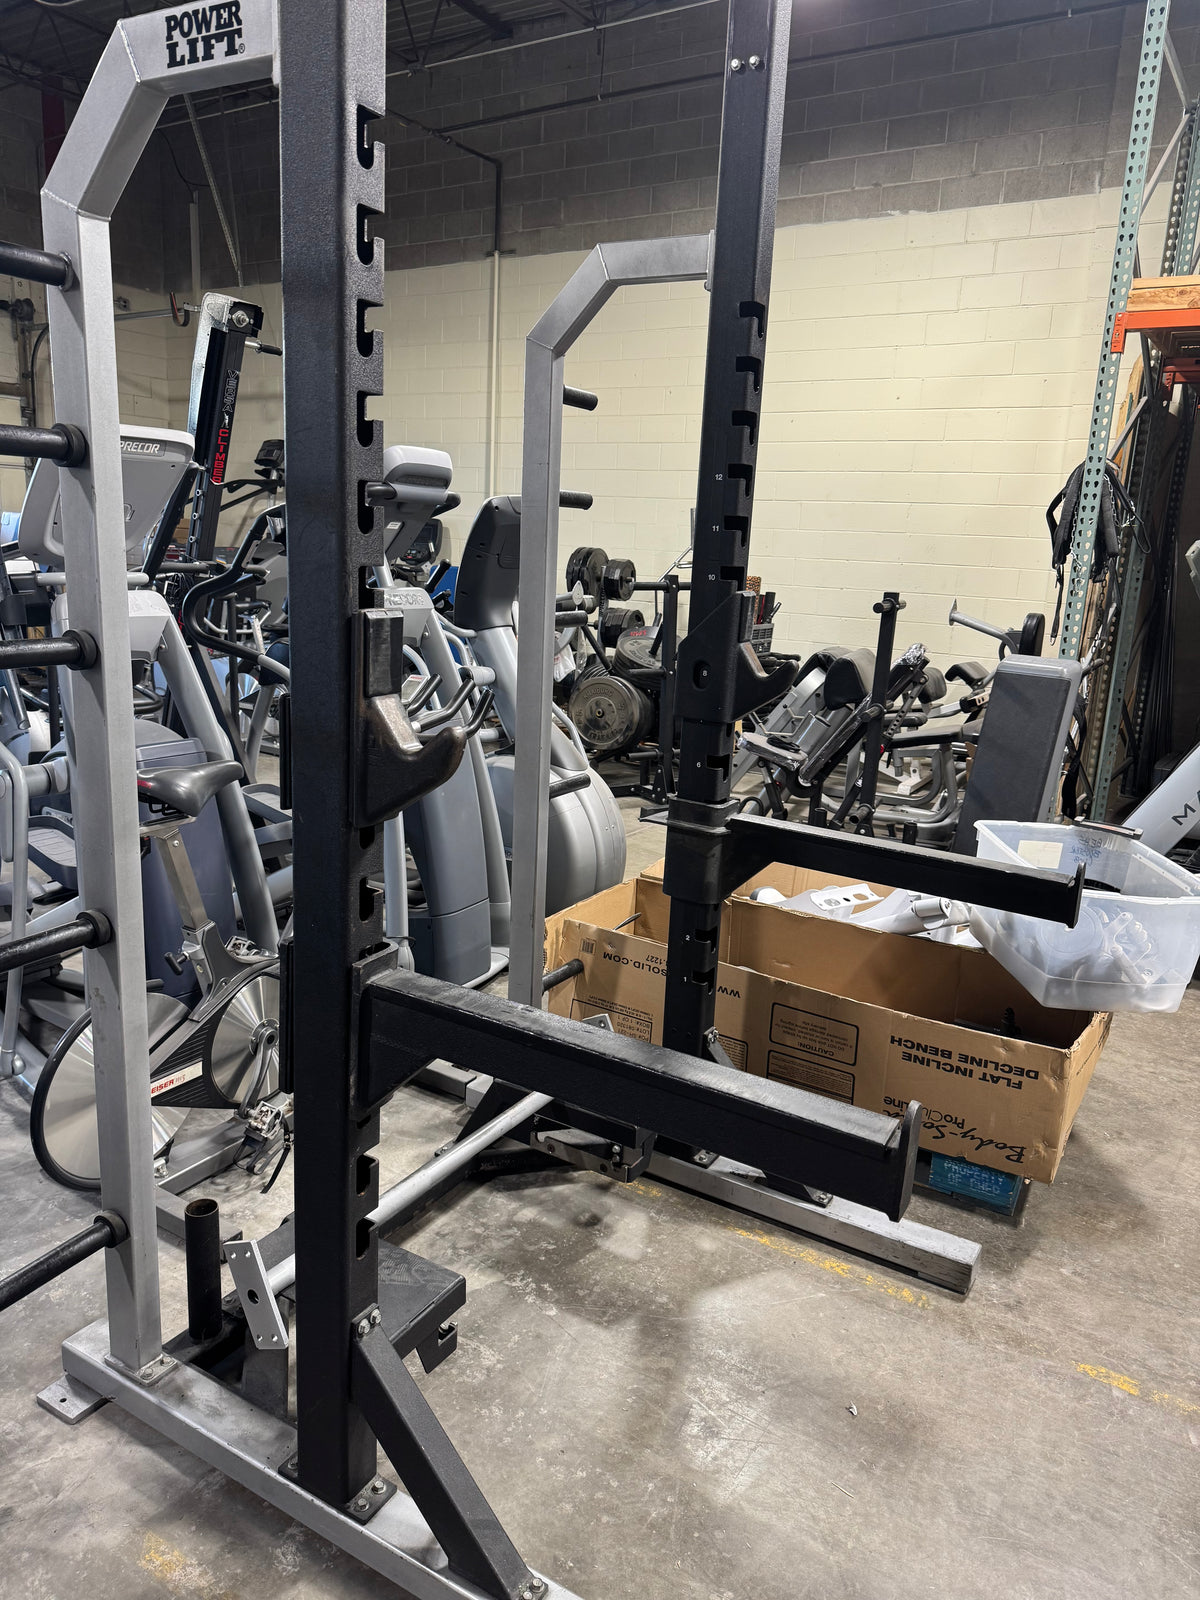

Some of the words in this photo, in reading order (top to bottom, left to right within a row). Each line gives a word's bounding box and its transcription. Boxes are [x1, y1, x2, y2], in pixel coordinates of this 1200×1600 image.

[165, 0, 242, 42] POWER
[166, 27, 242, 69] LIFT
[603, 951, 668, 976] SOLID.COM
[646, 954, 668, 967] .1227
[797, 1041, 834, 1057] CAUTION:
[890, 1035, 952, 1060] BENCH
[901, 1051, 973, 1078] INCLINE
[958, 1053, 1039, 1080] DECLINE
[151, 1078, 174, 1094] EISER
[979, 1072, 1023, 1090] FLAT
